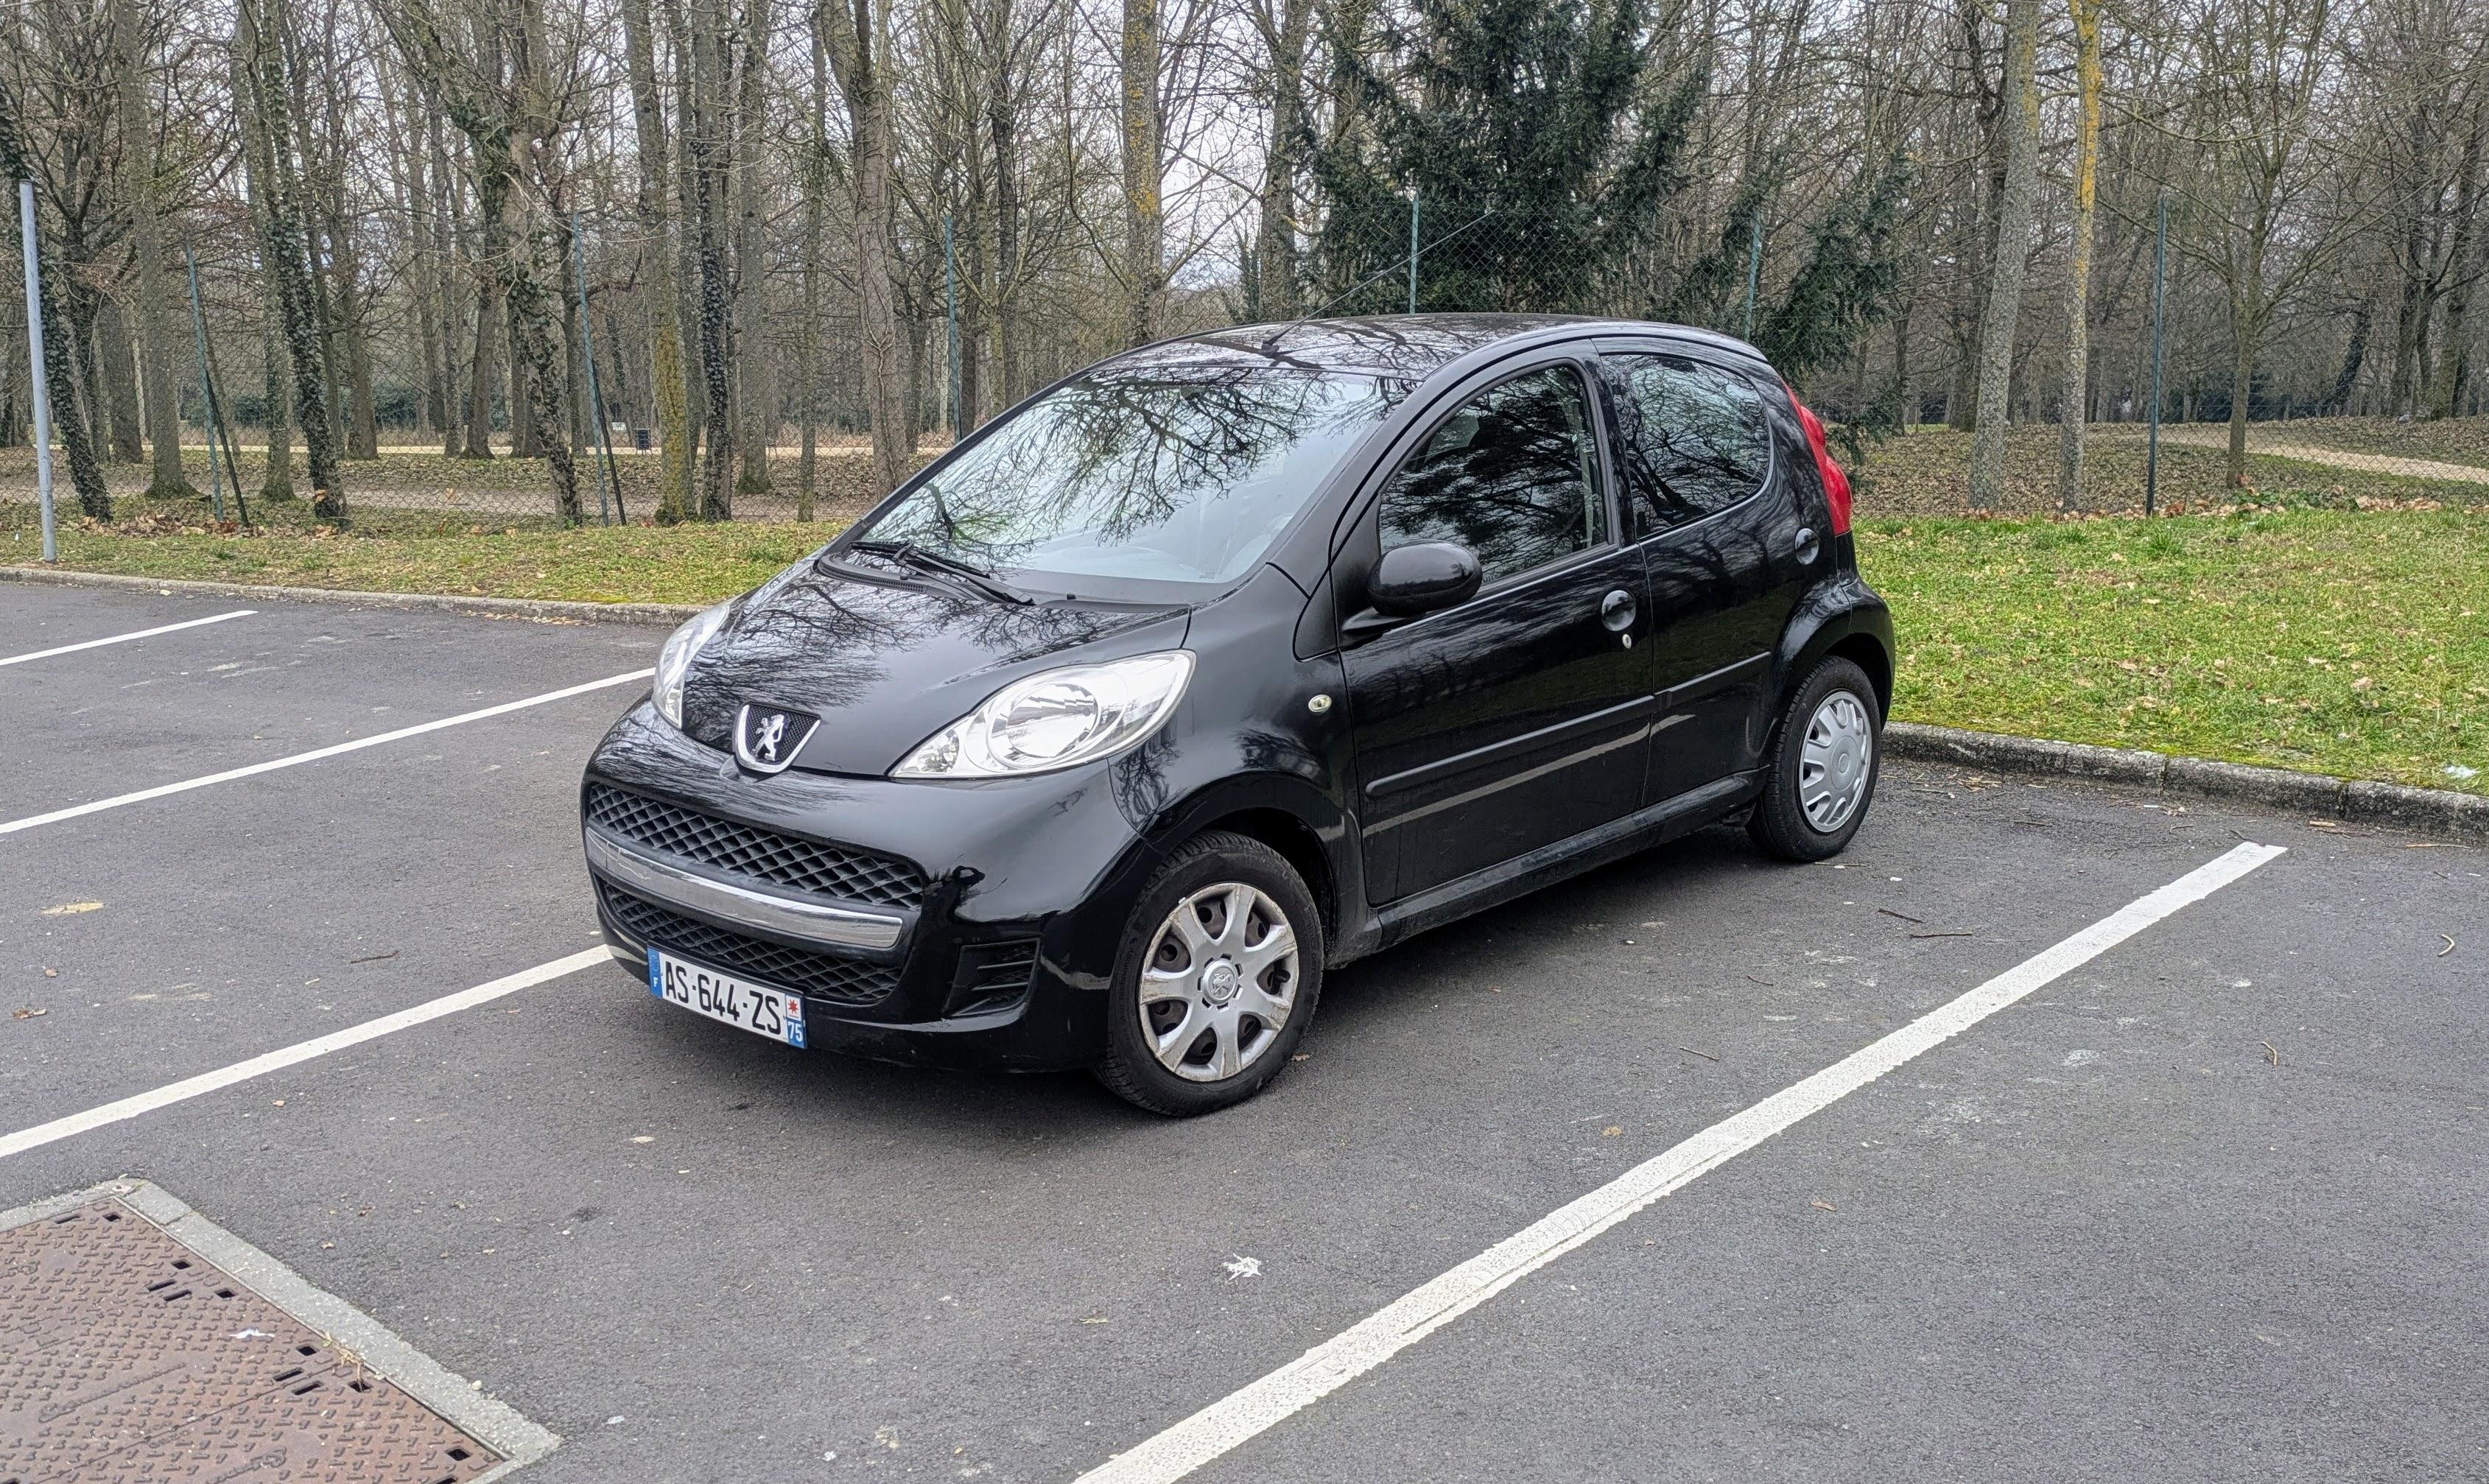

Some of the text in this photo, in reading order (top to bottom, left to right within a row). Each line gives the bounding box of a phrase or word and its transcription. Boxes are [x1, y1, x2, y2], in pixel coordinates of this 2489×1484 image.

[653, 976, 659, 988] F
[665, 960, 782, 1035] AS-644-ZS
[787, 1021, 803, 1043] 75
